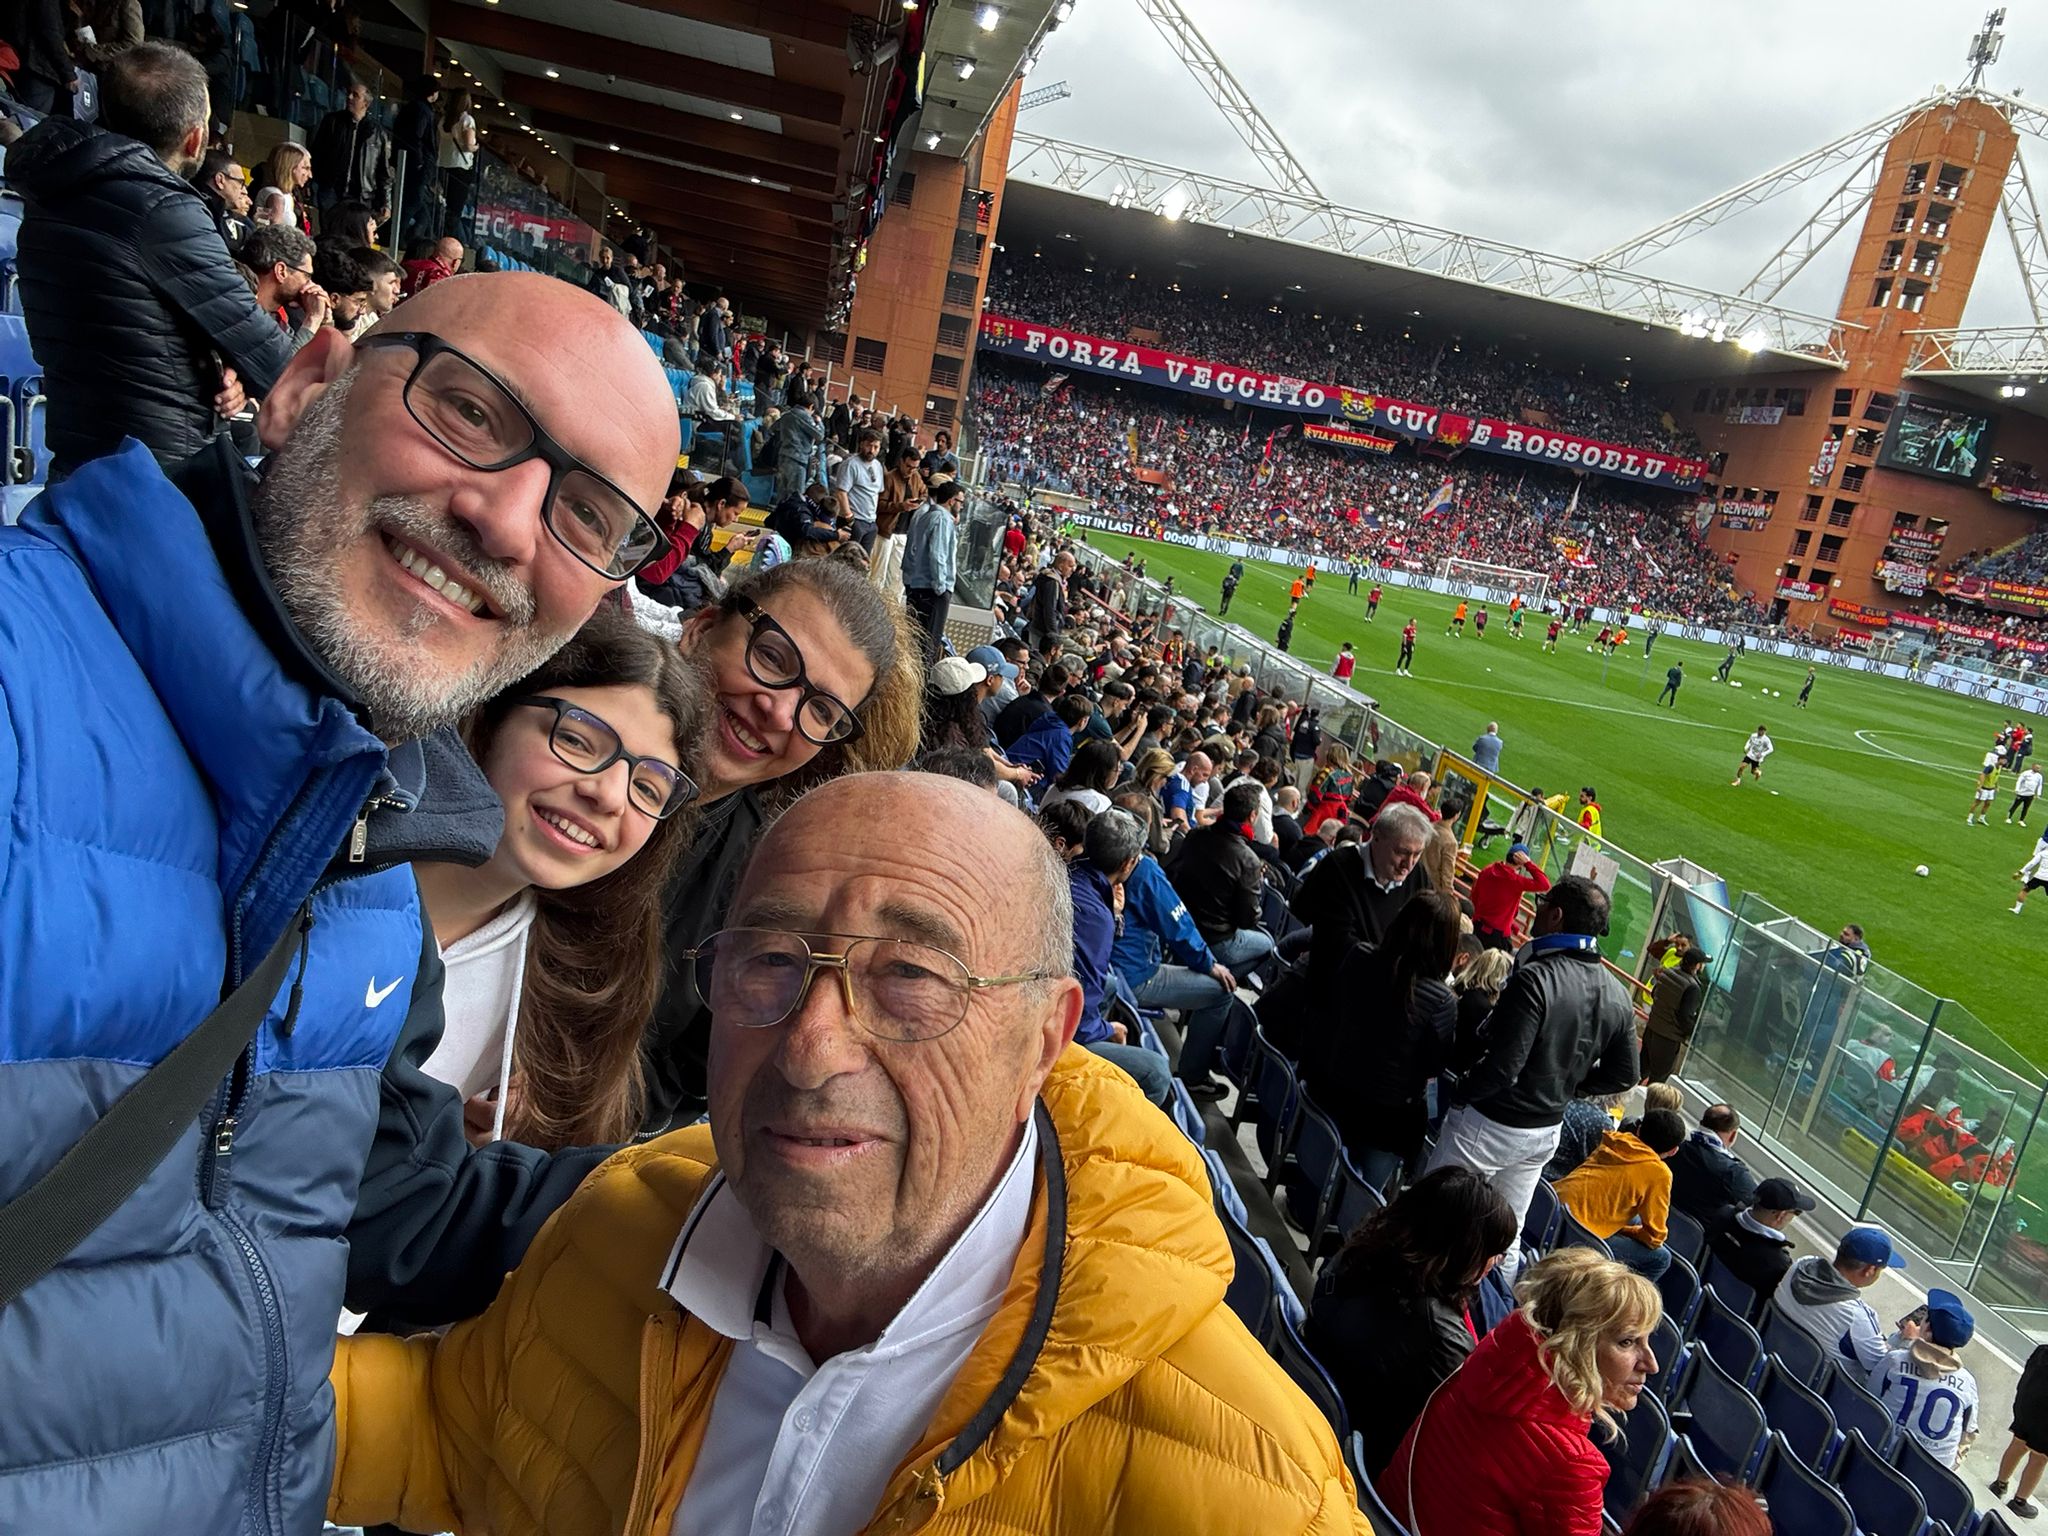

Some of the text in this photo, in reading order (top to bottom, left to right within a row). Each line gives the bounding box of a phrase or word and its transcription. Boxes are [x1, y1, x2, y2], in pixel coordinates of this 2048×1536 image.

[1023, 329, 1143, 376] FORZA
[1164, 358, 1326, 409] VECCHIO
[1501, 428, 1667, 480] ROSSOBLU
[1312, 429, 1329, 441] VIA
[1331, 433, 1374, 449] ARMENIA
[1061, 511, 1093, 527] FRST
[1093, 517, 1107, 530] IN
[1108, 520, 1134, 535] LAST
[1163, 530, 1197, 547] 00:00
[1949, 623, 1995, 640] GENOA CLUB
[1938, 1375, 1964, 1392] PAZ
[1896, 1376, 1961, 1441] 10
